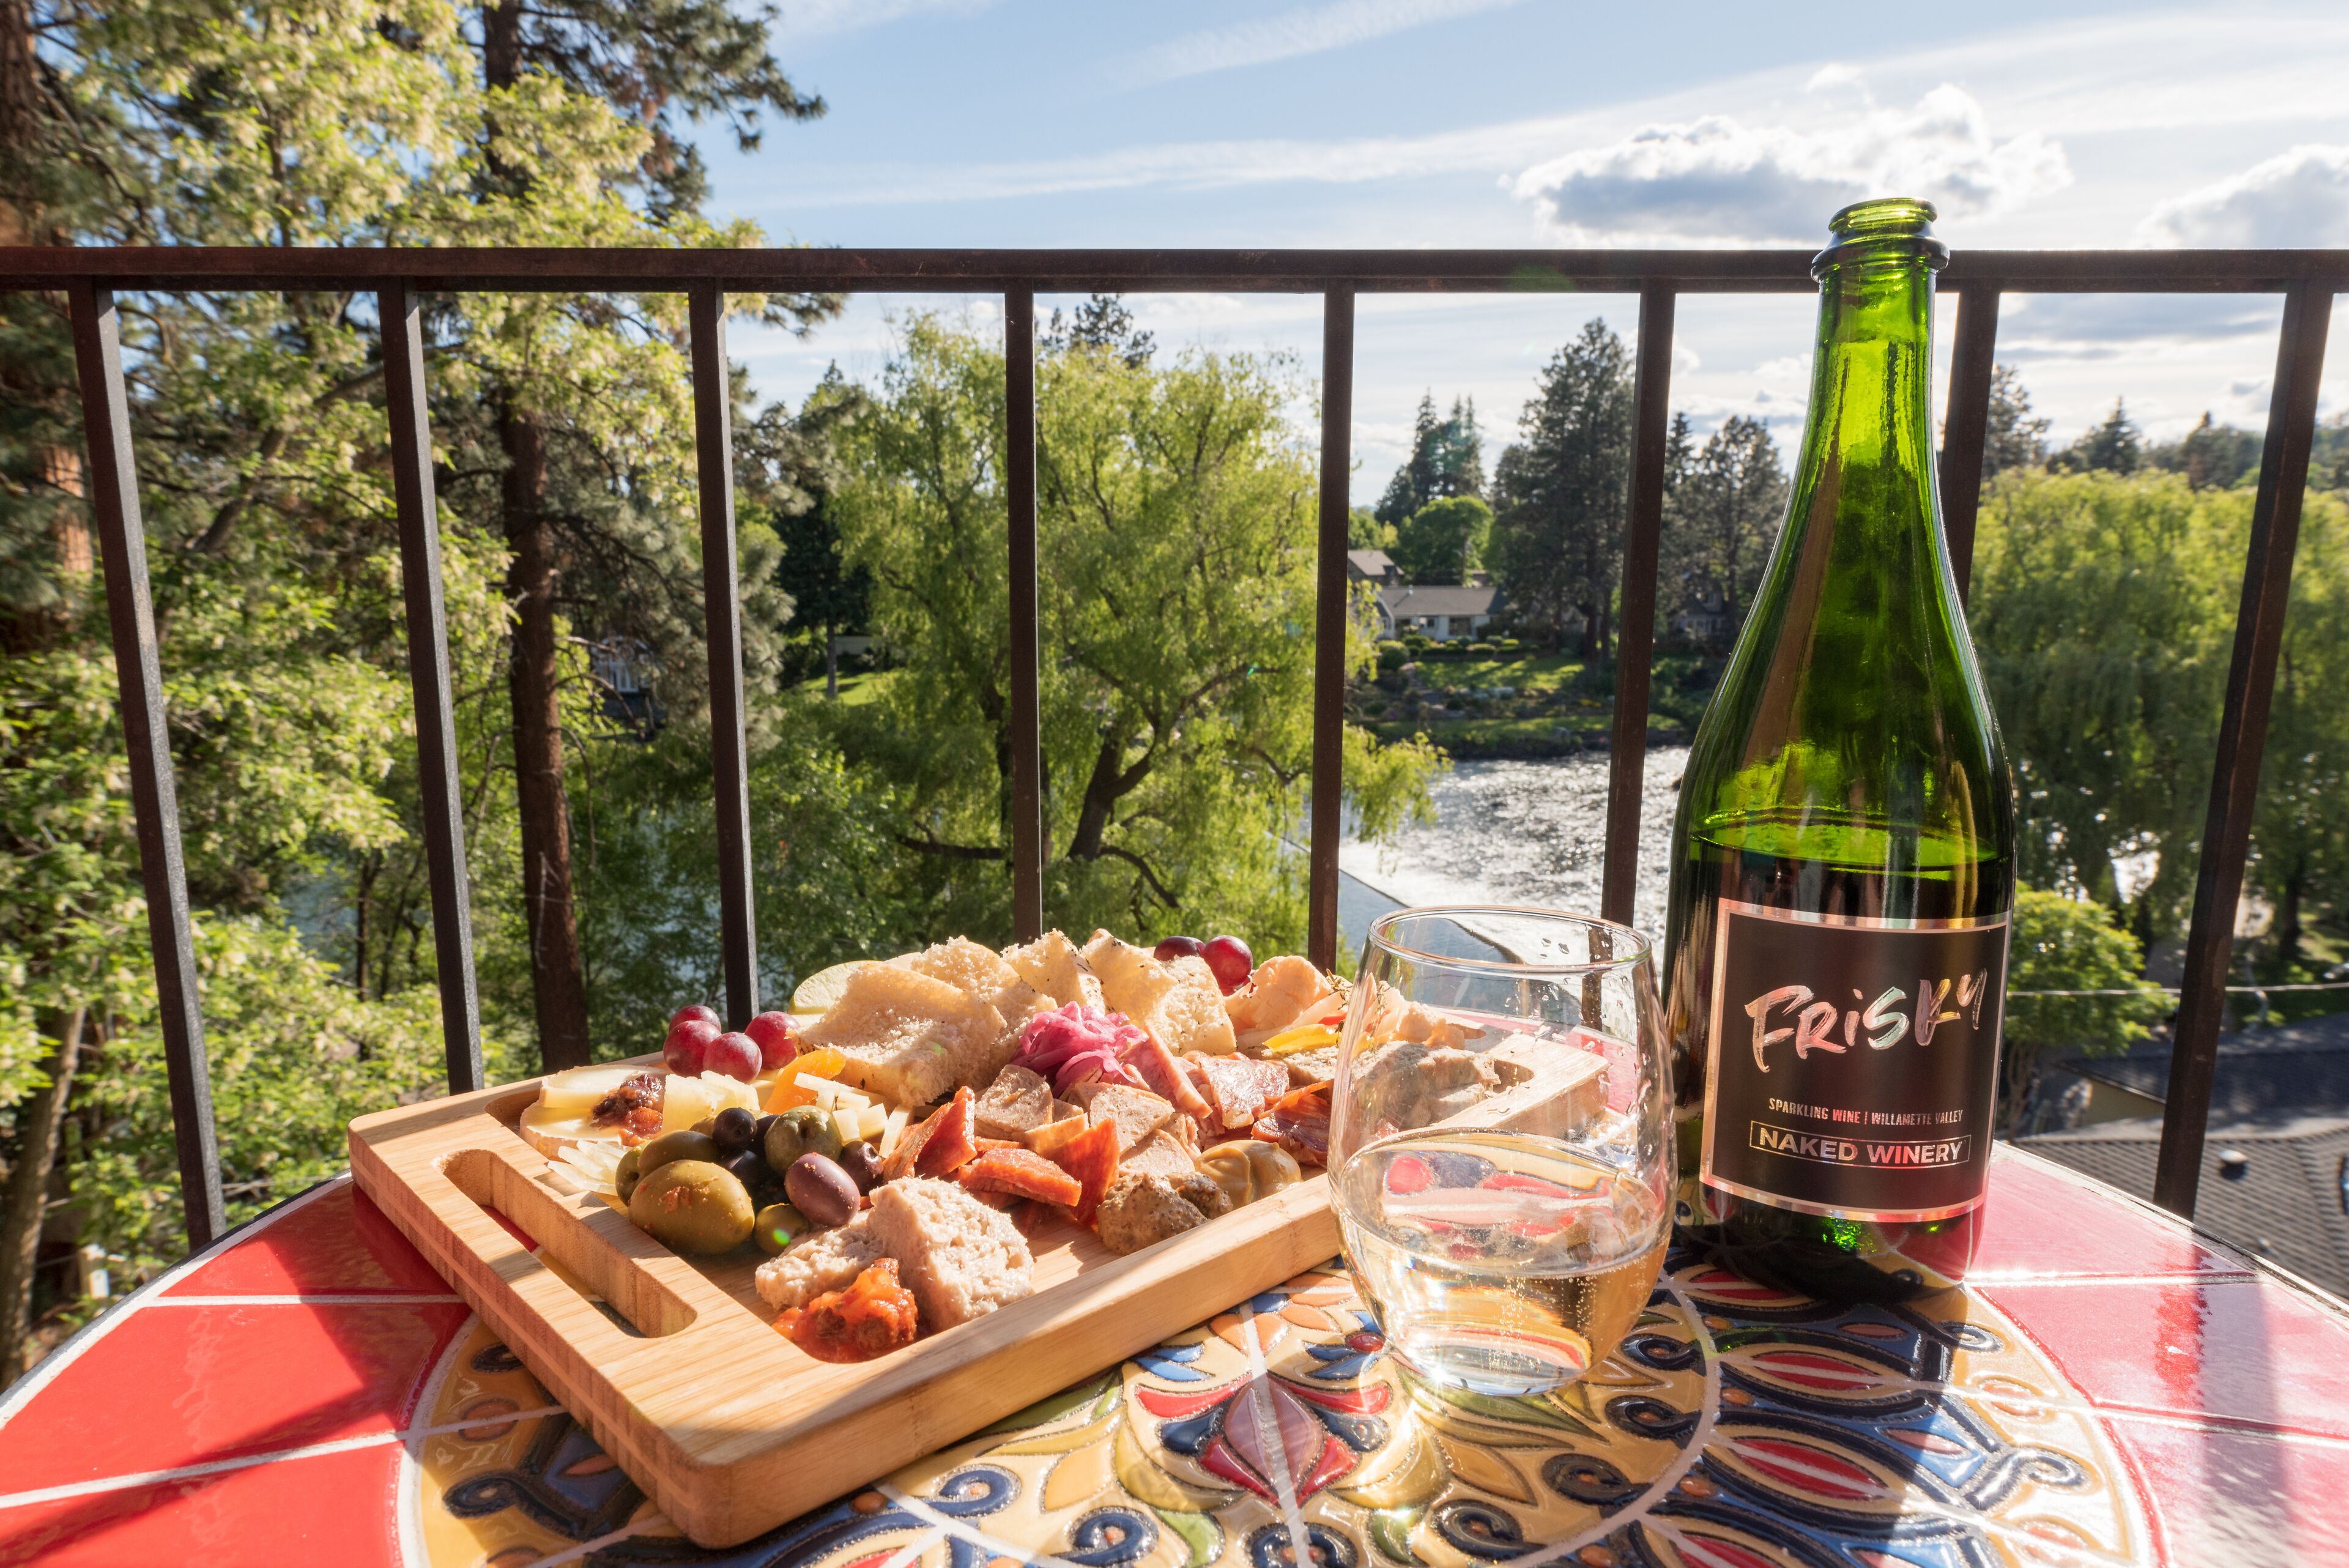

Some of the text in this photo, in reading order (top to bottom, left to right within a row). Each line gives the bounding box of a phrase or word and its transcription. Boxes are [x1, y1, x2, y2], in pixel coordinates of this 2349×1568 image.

[1768, 1098, 1963, 1126] SPARKLING WINE WILLAMETTE VALLEY
[1759, 1127, 1963, 1164] NAKED WINERY
